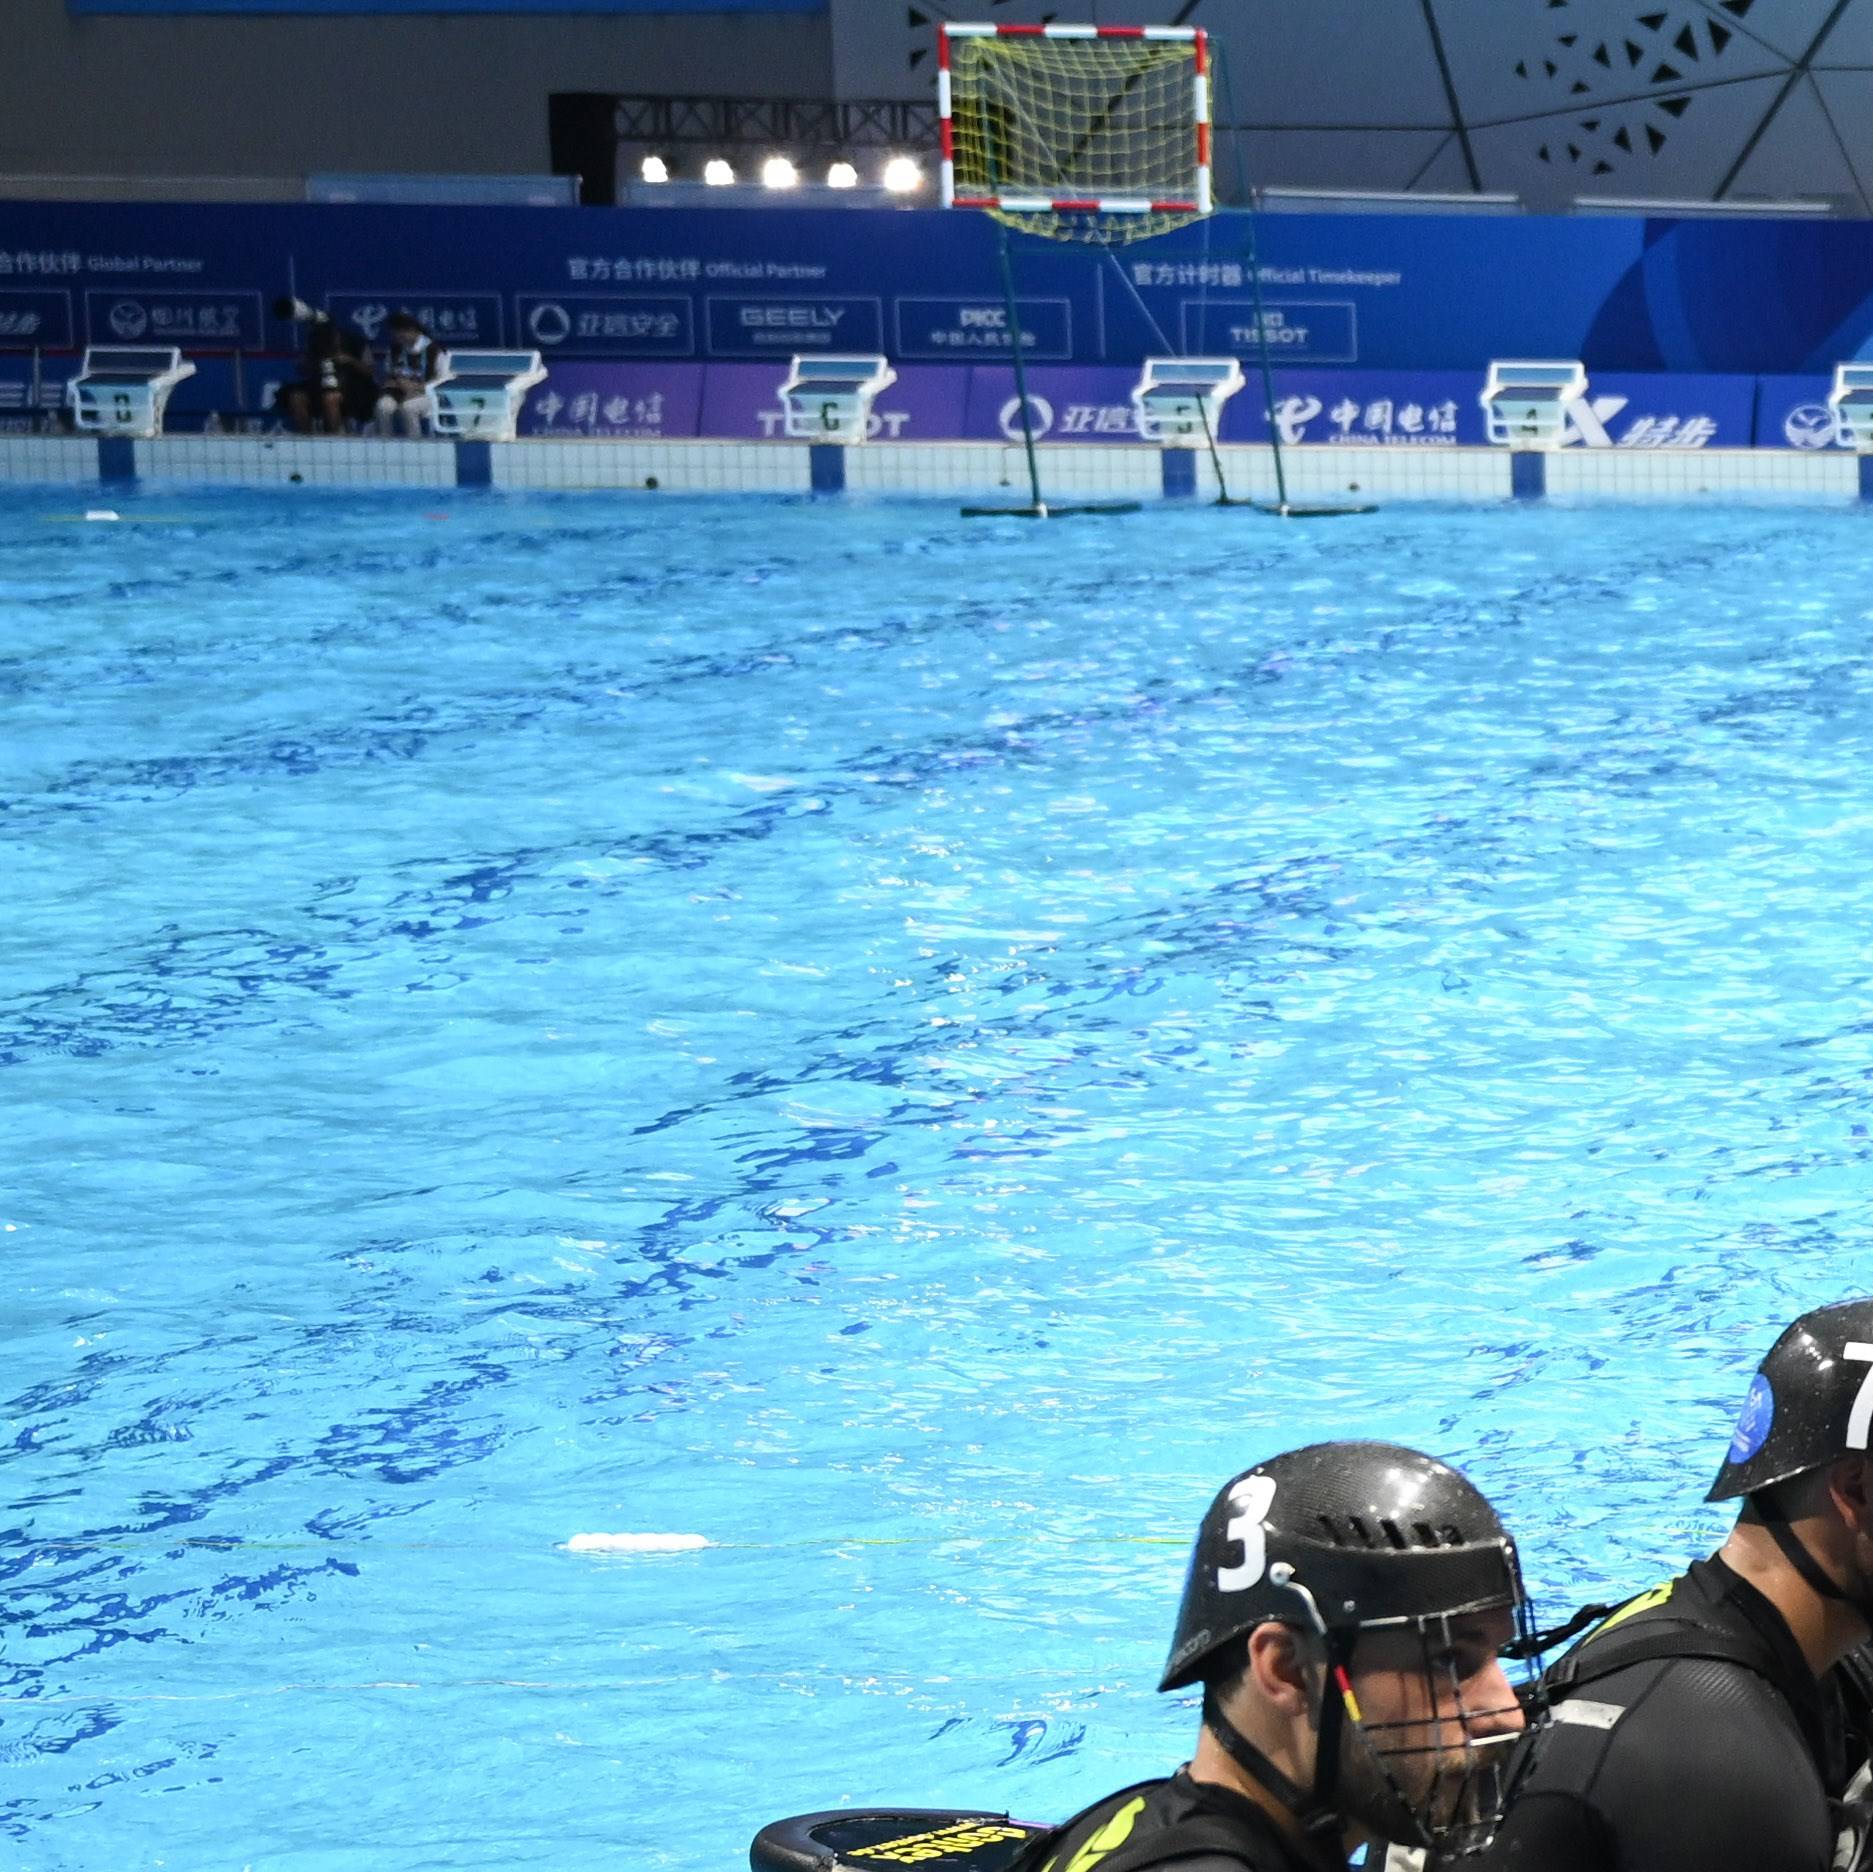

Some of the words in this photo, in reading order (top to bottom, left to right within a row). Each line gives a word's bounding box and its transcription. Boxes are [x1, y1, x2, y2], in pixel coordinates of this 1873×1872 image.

[706, 263, 762, 279] Official
[767, 265, 826, 279] Partner
[740, 307, 845, 327] GEELY
[1329, 398, 1459, 434] 中国电信
[1217, 1473, 1278, 1592] 3
